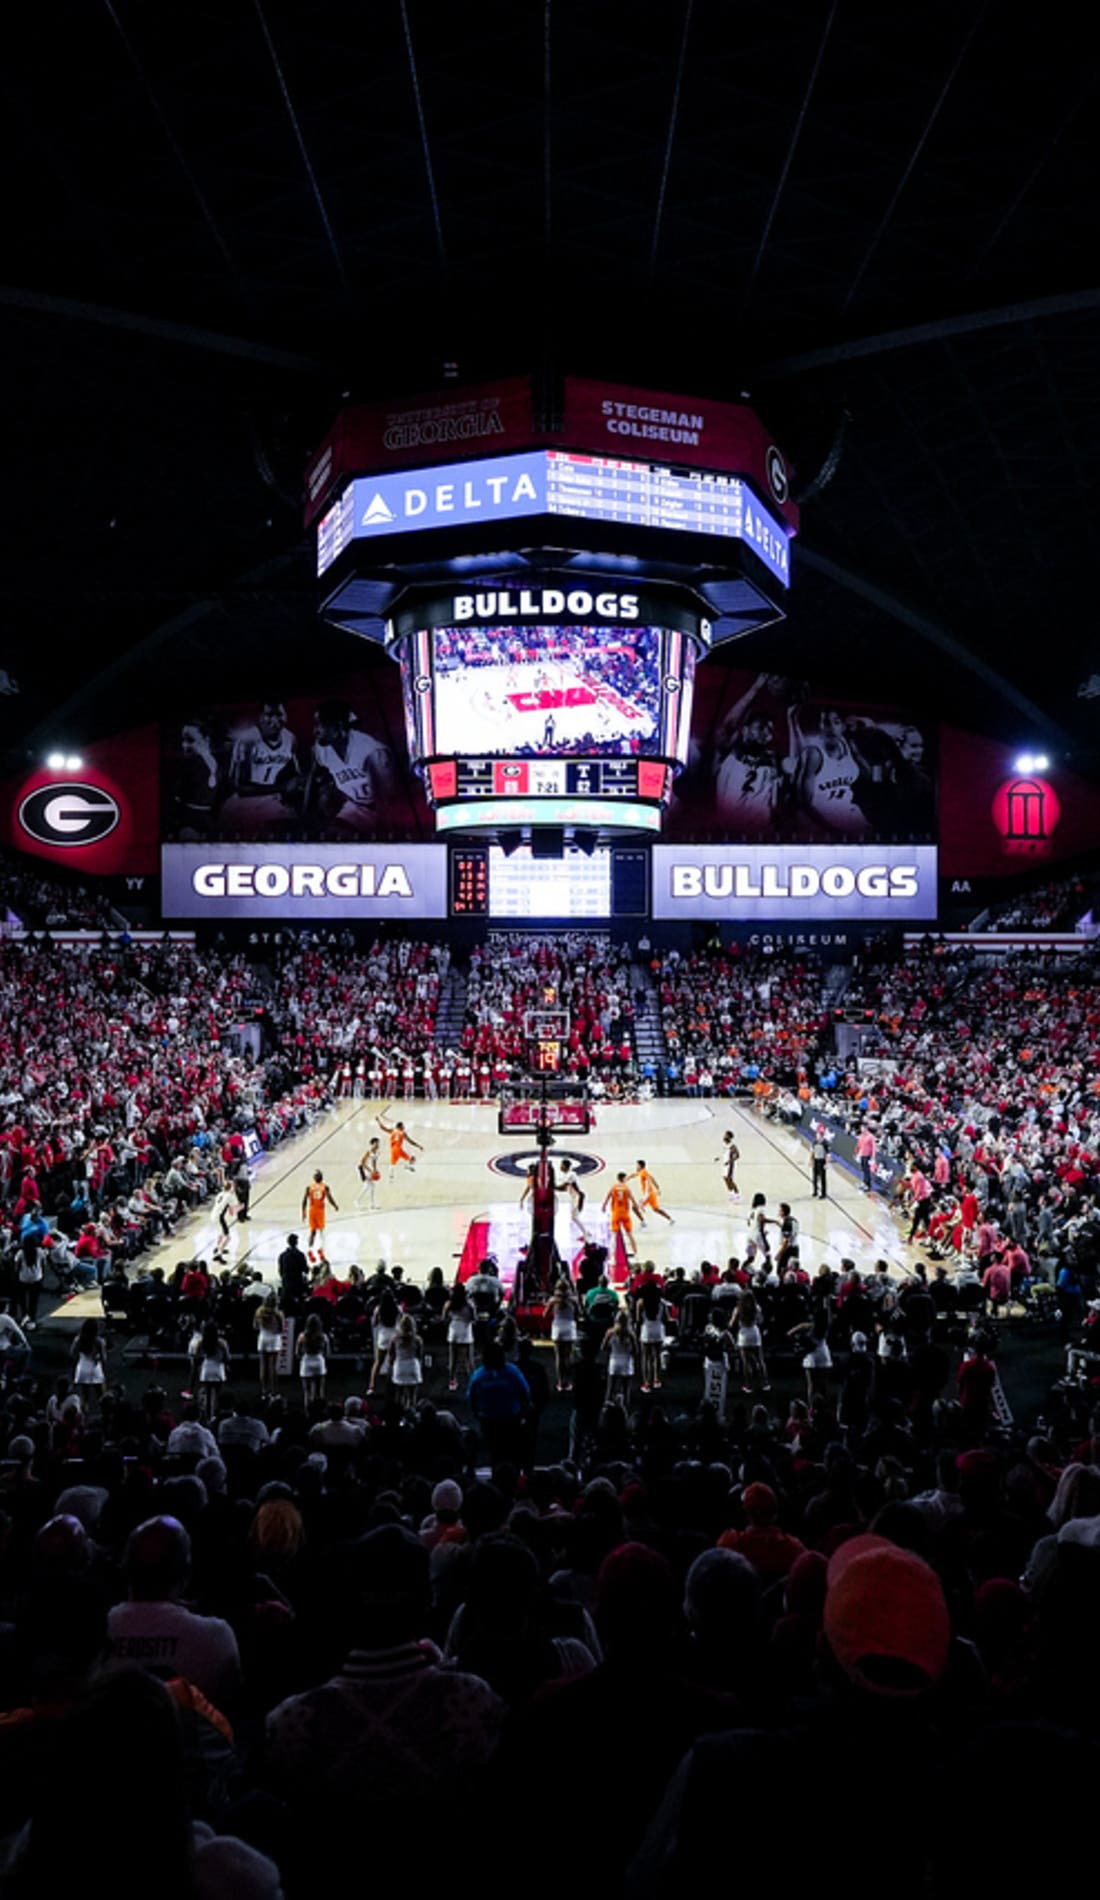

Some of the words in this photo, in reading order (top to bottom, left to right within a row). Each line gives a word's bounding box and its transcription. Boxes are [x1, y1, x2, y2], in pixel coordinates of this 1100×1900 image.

[601, 400, 703, 429] STEGEMAN
[383, 411, 506, 449] GEORGIA
[606, 418, 700, 446] COLISEUM
[404, 473, 537, 517] DELTA
[755, 516, 788, 573] DELTA
[454, 590, 639, 621] BULLDOGS
[126, 877, 144, 890] YY
[193, 864, 412, 898] GEORGIA
[672, 864, 919, 898] BULLDOGS
[950, 880, 971, 894] AA
[749, 933, 848, 946] COLISEUM
[539, 1052, 556, 1070] 19
